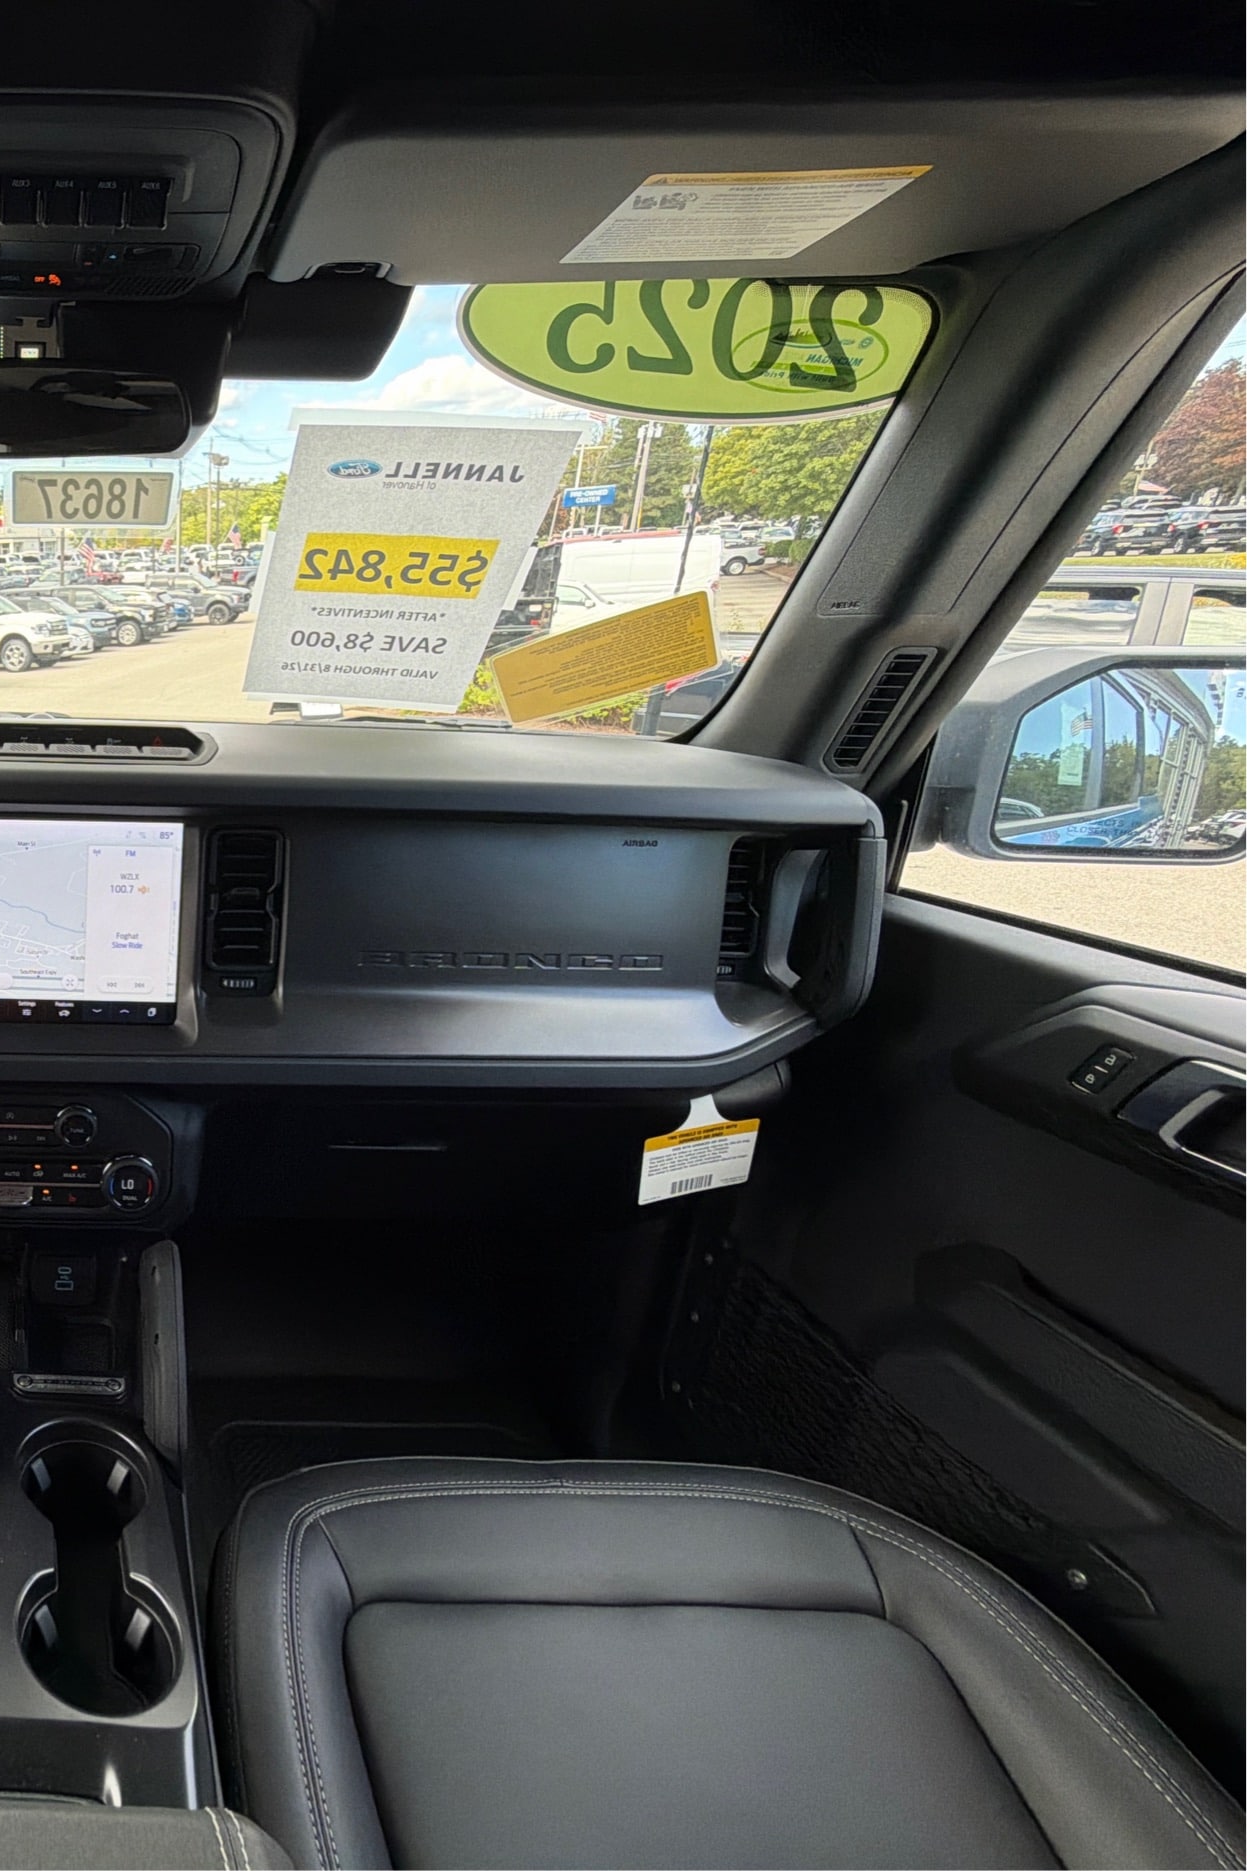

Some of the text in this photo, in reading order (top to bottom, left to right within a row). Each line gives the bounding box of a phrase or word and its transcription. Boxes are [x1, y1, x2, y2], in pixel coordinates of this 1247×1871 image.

[622, 839, 658, 848] AIRBAG
[110, 885, 134, 894] 100.7
[116, 932, 139, 941] Foghat
[112, 941, 127, 949] Slow
[358, 950, 664, 971] BRONCO
[121, 1179, 135, 1190] LO
